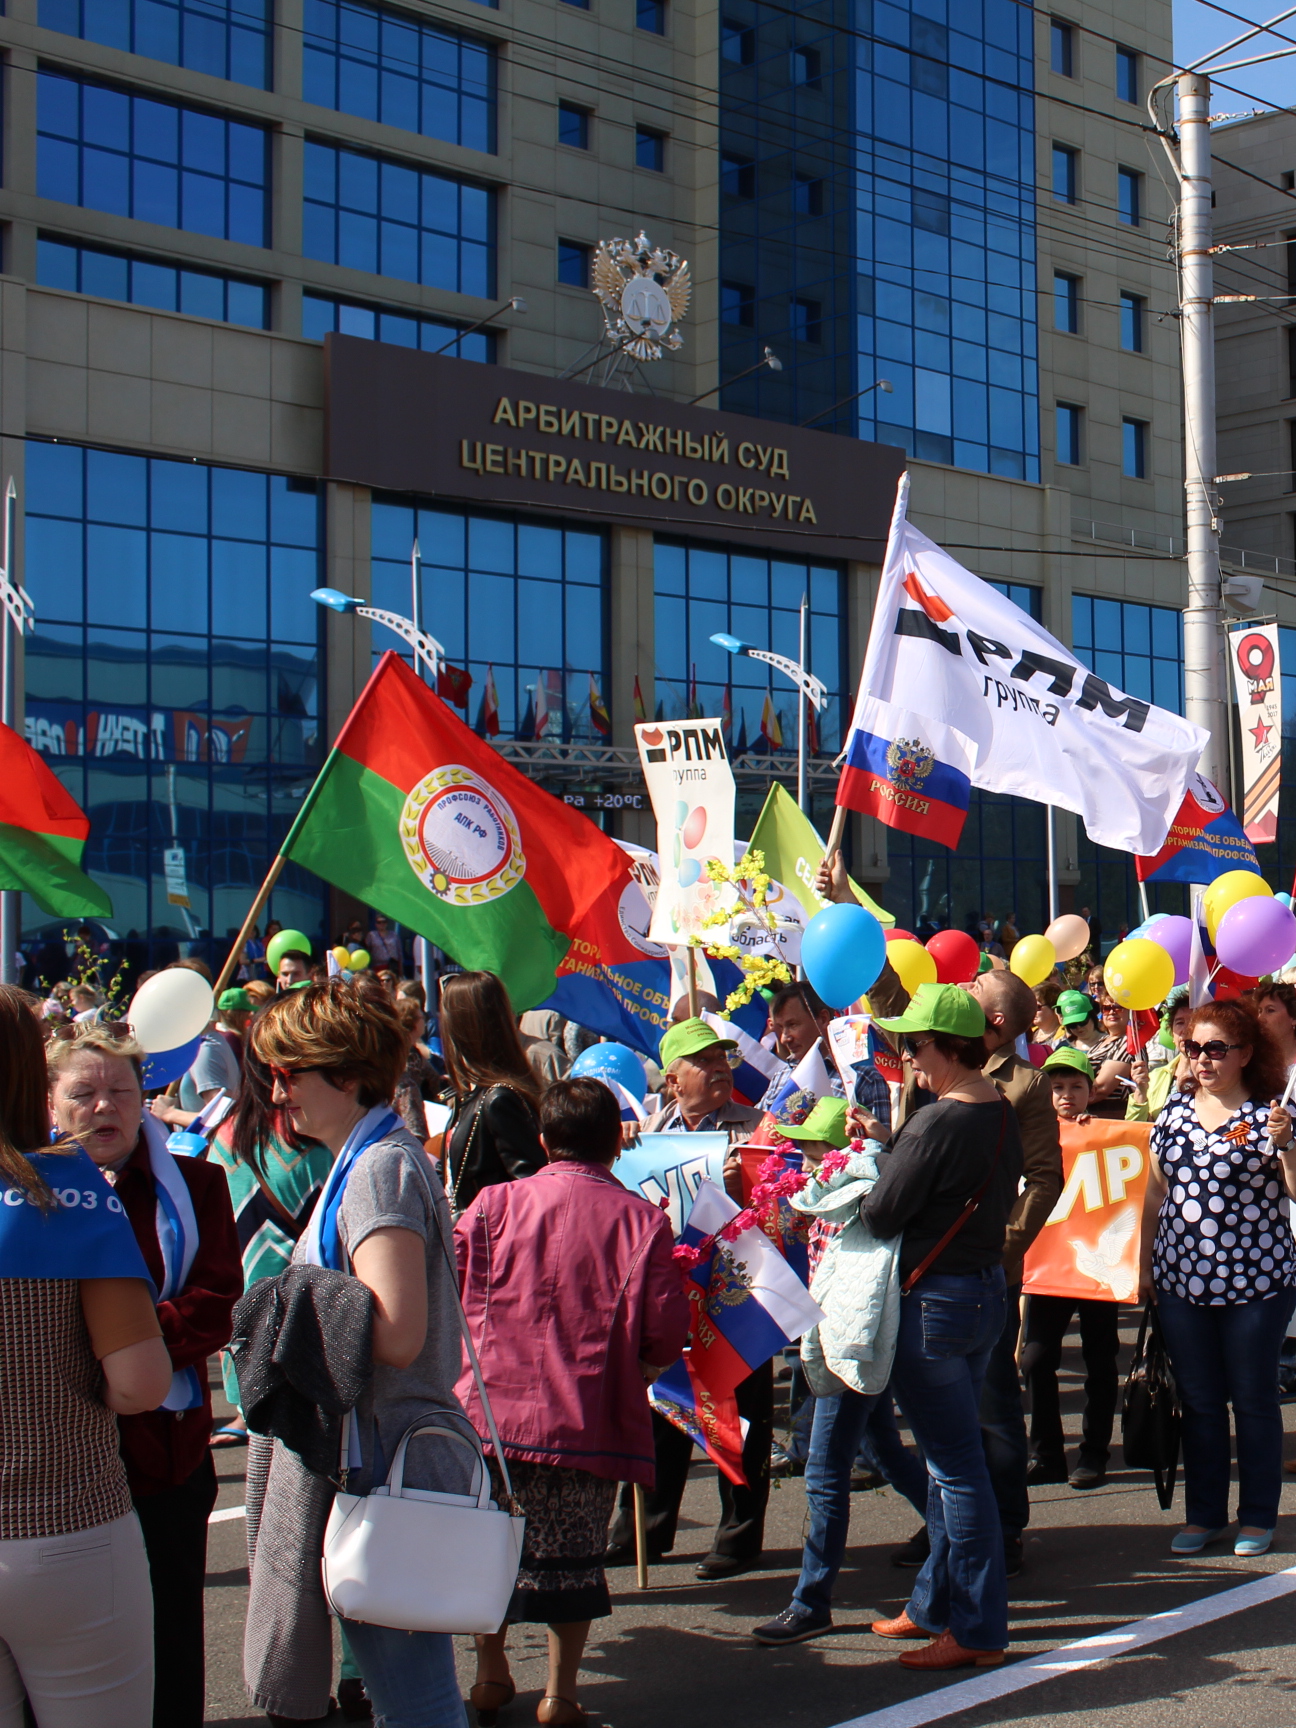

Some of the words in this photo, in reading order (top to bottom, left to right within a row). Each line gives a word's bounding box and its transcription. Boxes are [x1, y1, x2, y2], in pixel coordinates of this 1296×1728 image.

[494, 397, 729, 465] АРБИТРАЖНЫЙ
[738, 441, 790, 480] СУД
[460, 439, 708, 506] ЦЕНТРАЛЬНОГО
[717, 483, 817, 524] ОКРУГА
[983, 675, 1060, 727] группа
[1247, 675, 1274, 695] МАЯ
[667, 728, 725, 761] РПМ
[436, 793, 481, 811] ПРОФСОЮЗ
[869, 779, 931, 815] РОССИЯ
[454, 812, 475, 831] АПК
[472, 824, 488, 839] РФ
